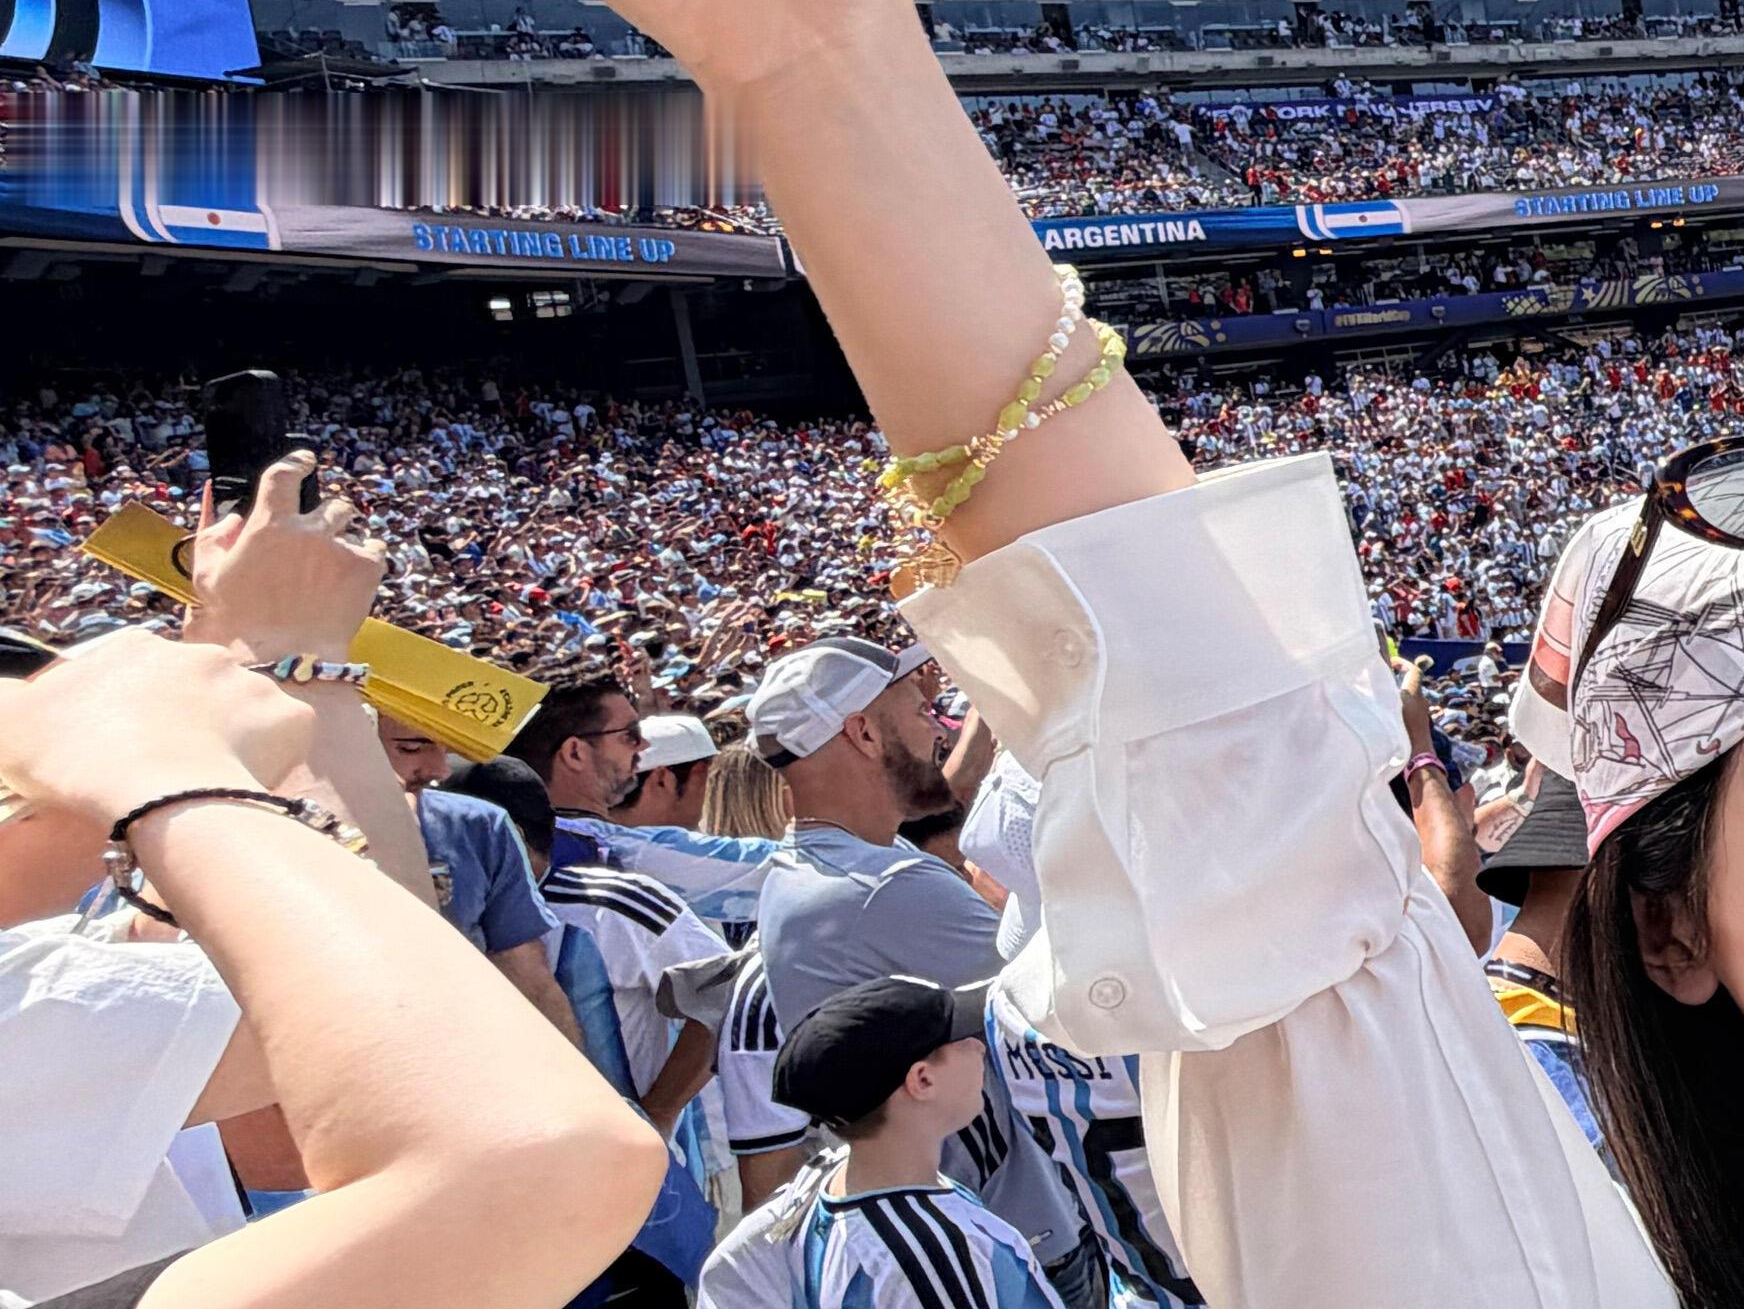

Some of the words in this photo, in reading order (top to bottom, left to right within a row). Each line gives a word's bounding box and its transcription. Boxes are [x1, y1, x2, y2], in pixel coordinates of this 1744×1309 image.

[1268, 105, 1330, 120] ORK
[1514, 191, 1630, 217] STARTING
[1634, 187, 1685, 209] LINE
[1688, 184, 1719, 204] UP
[412, 223, 564, 259] STARTING
[569, 234, 633, 262] LINE
[639, 238, 675, 264] UP
[1044, 220, 1206, 251] ARGENTINA
